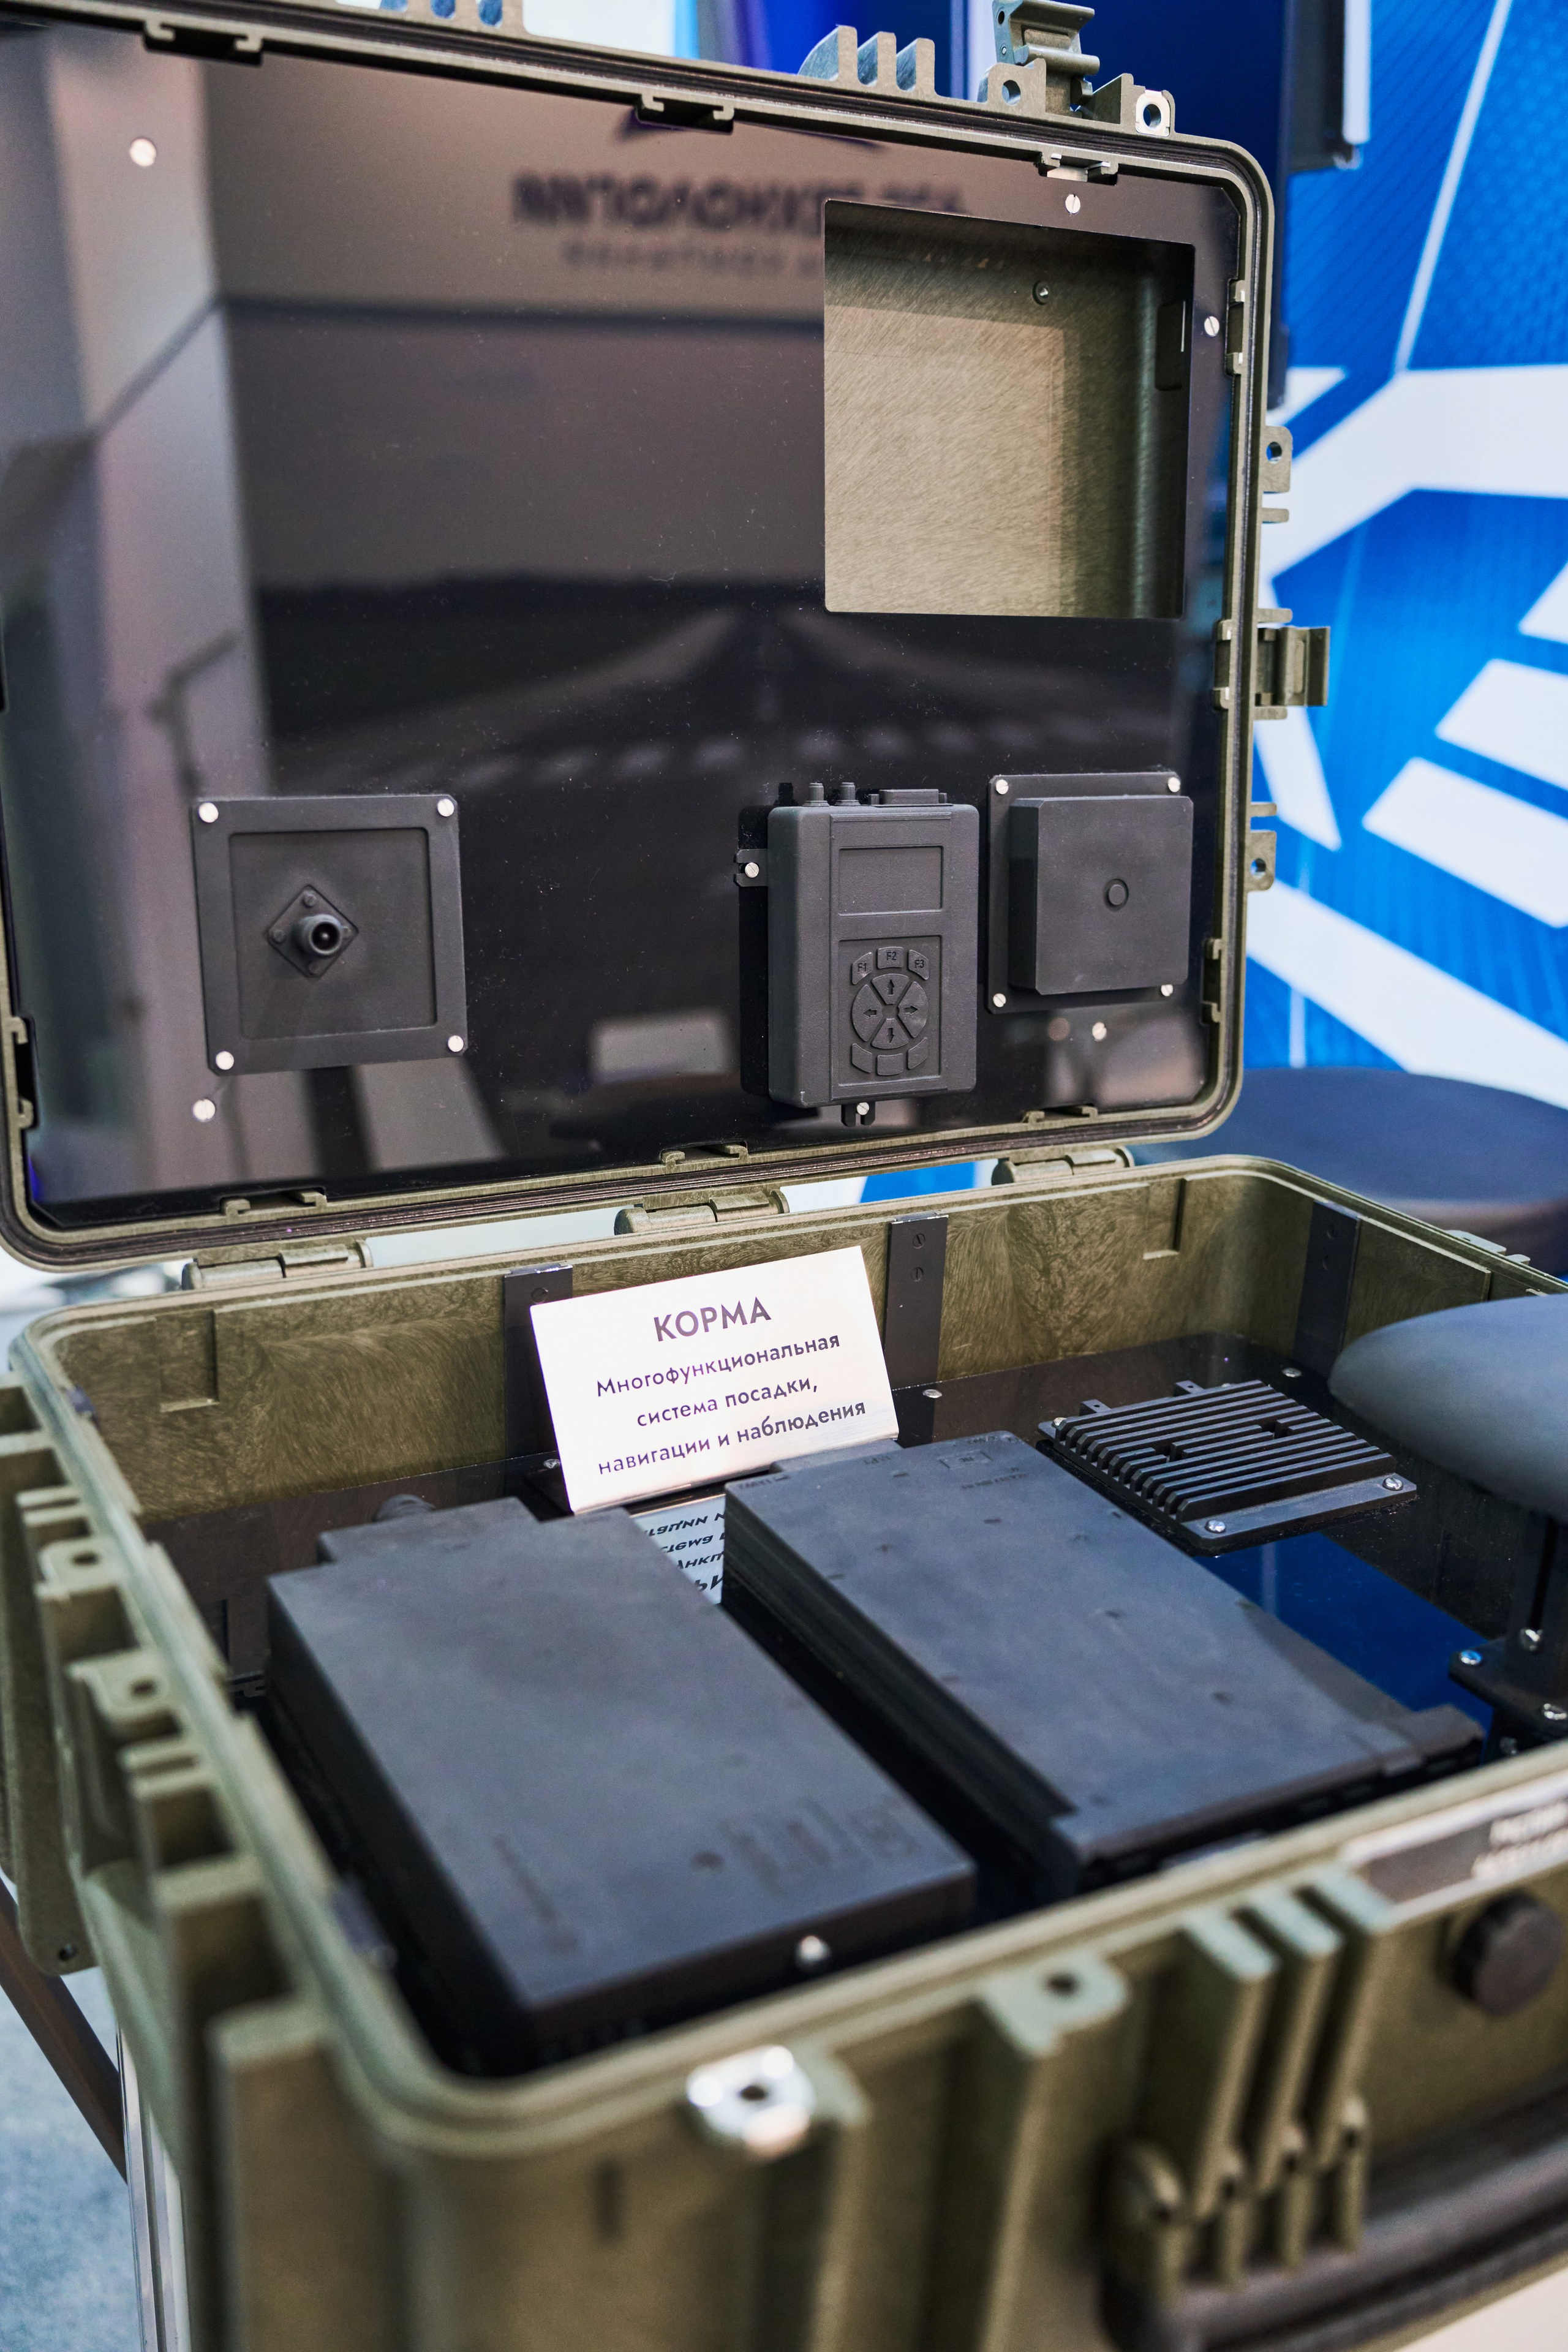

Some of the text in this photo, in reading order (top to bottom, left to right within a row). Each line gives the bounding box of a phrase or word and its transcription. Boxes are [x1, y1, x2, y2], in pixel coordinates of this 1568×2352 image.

[858, 962, 867, 972] F1
[886, 951, 897, 961] F2
[914, 959, 924, 969] F3
[653, 1296, 772, 1342] КОРМА
[597, 1335, 840, 1397] Многофункциональная
[637, 1378, 818, 1427] система посадки,
[598, 1402, 866, 1475] навигации и наблюдения
